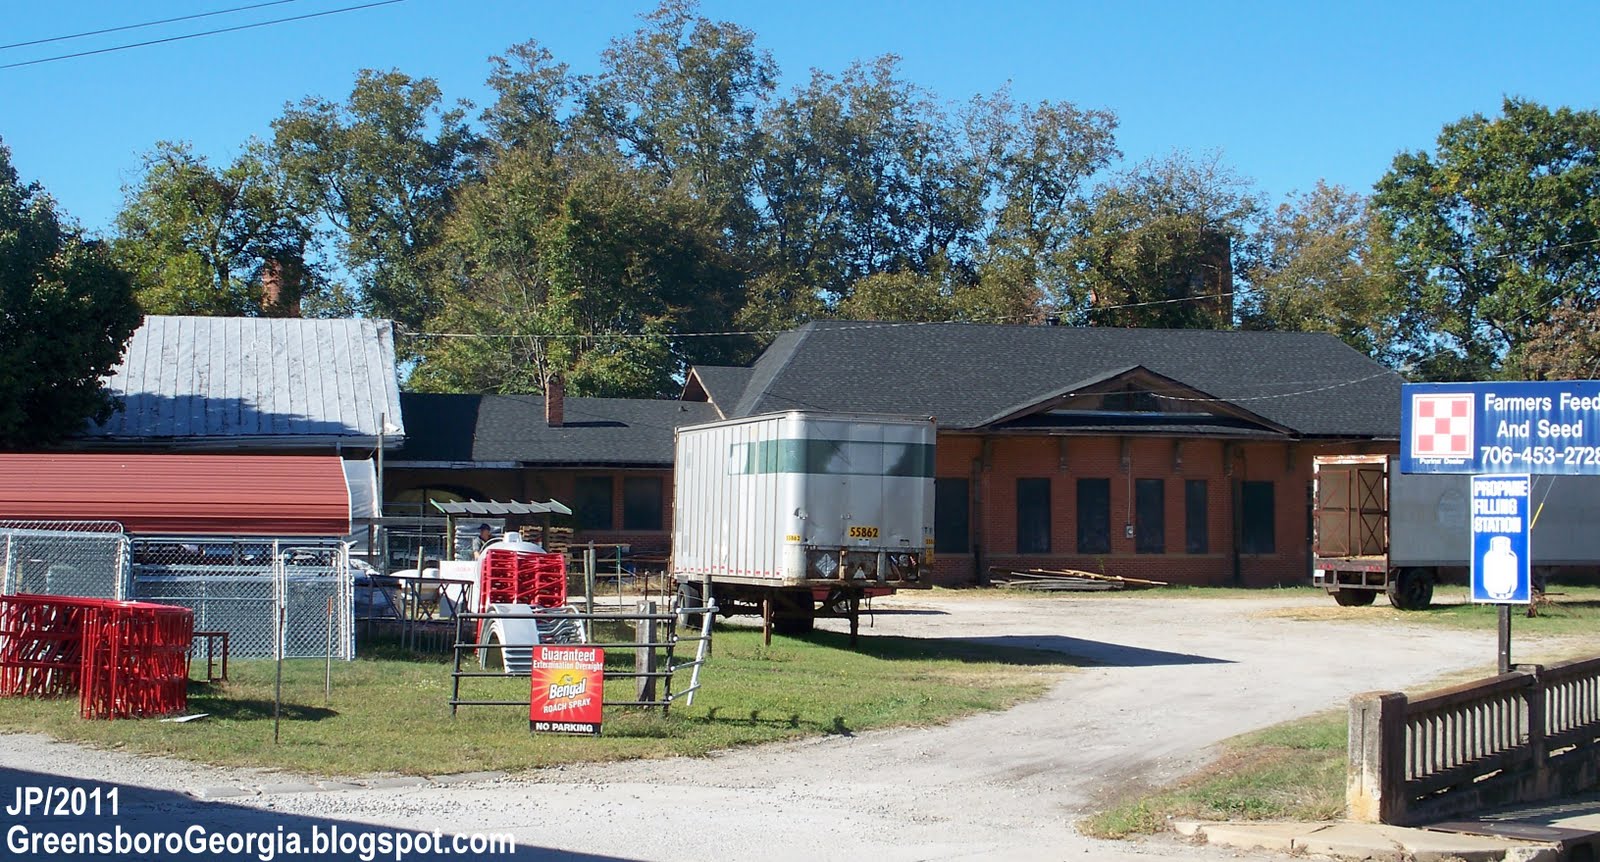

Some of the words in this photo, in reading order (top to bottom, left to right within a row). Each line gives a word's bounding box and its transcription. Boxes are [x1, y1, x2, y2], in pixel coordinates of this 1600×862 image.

[1484, 393, 1552, 411] Farmers
[1560, 392, 1600, 411] Feed
[1496, 420, 1530, 438] And
[1537, 419, 1583, 438] Seed
[1474, 480, 1528, 497] PROPANE
[1474, 498, 1518, 515] FILLING
[850, 527, 879, 538] 55862
[1474, 516, 1522, 533] STATION
[542, 647, 595, 661] Guaranteed
[533, 660, 574, 669] Extermination
[575, 662, 603, 671] Overnight
[549, 678, 586, 699] Bengal
[543, 703, 567, 713] ROACH
[568, 698, 591, 708] SPRAY
[535, 722, 550, 730] NO
[552, 723, 593, 732] PARKING
